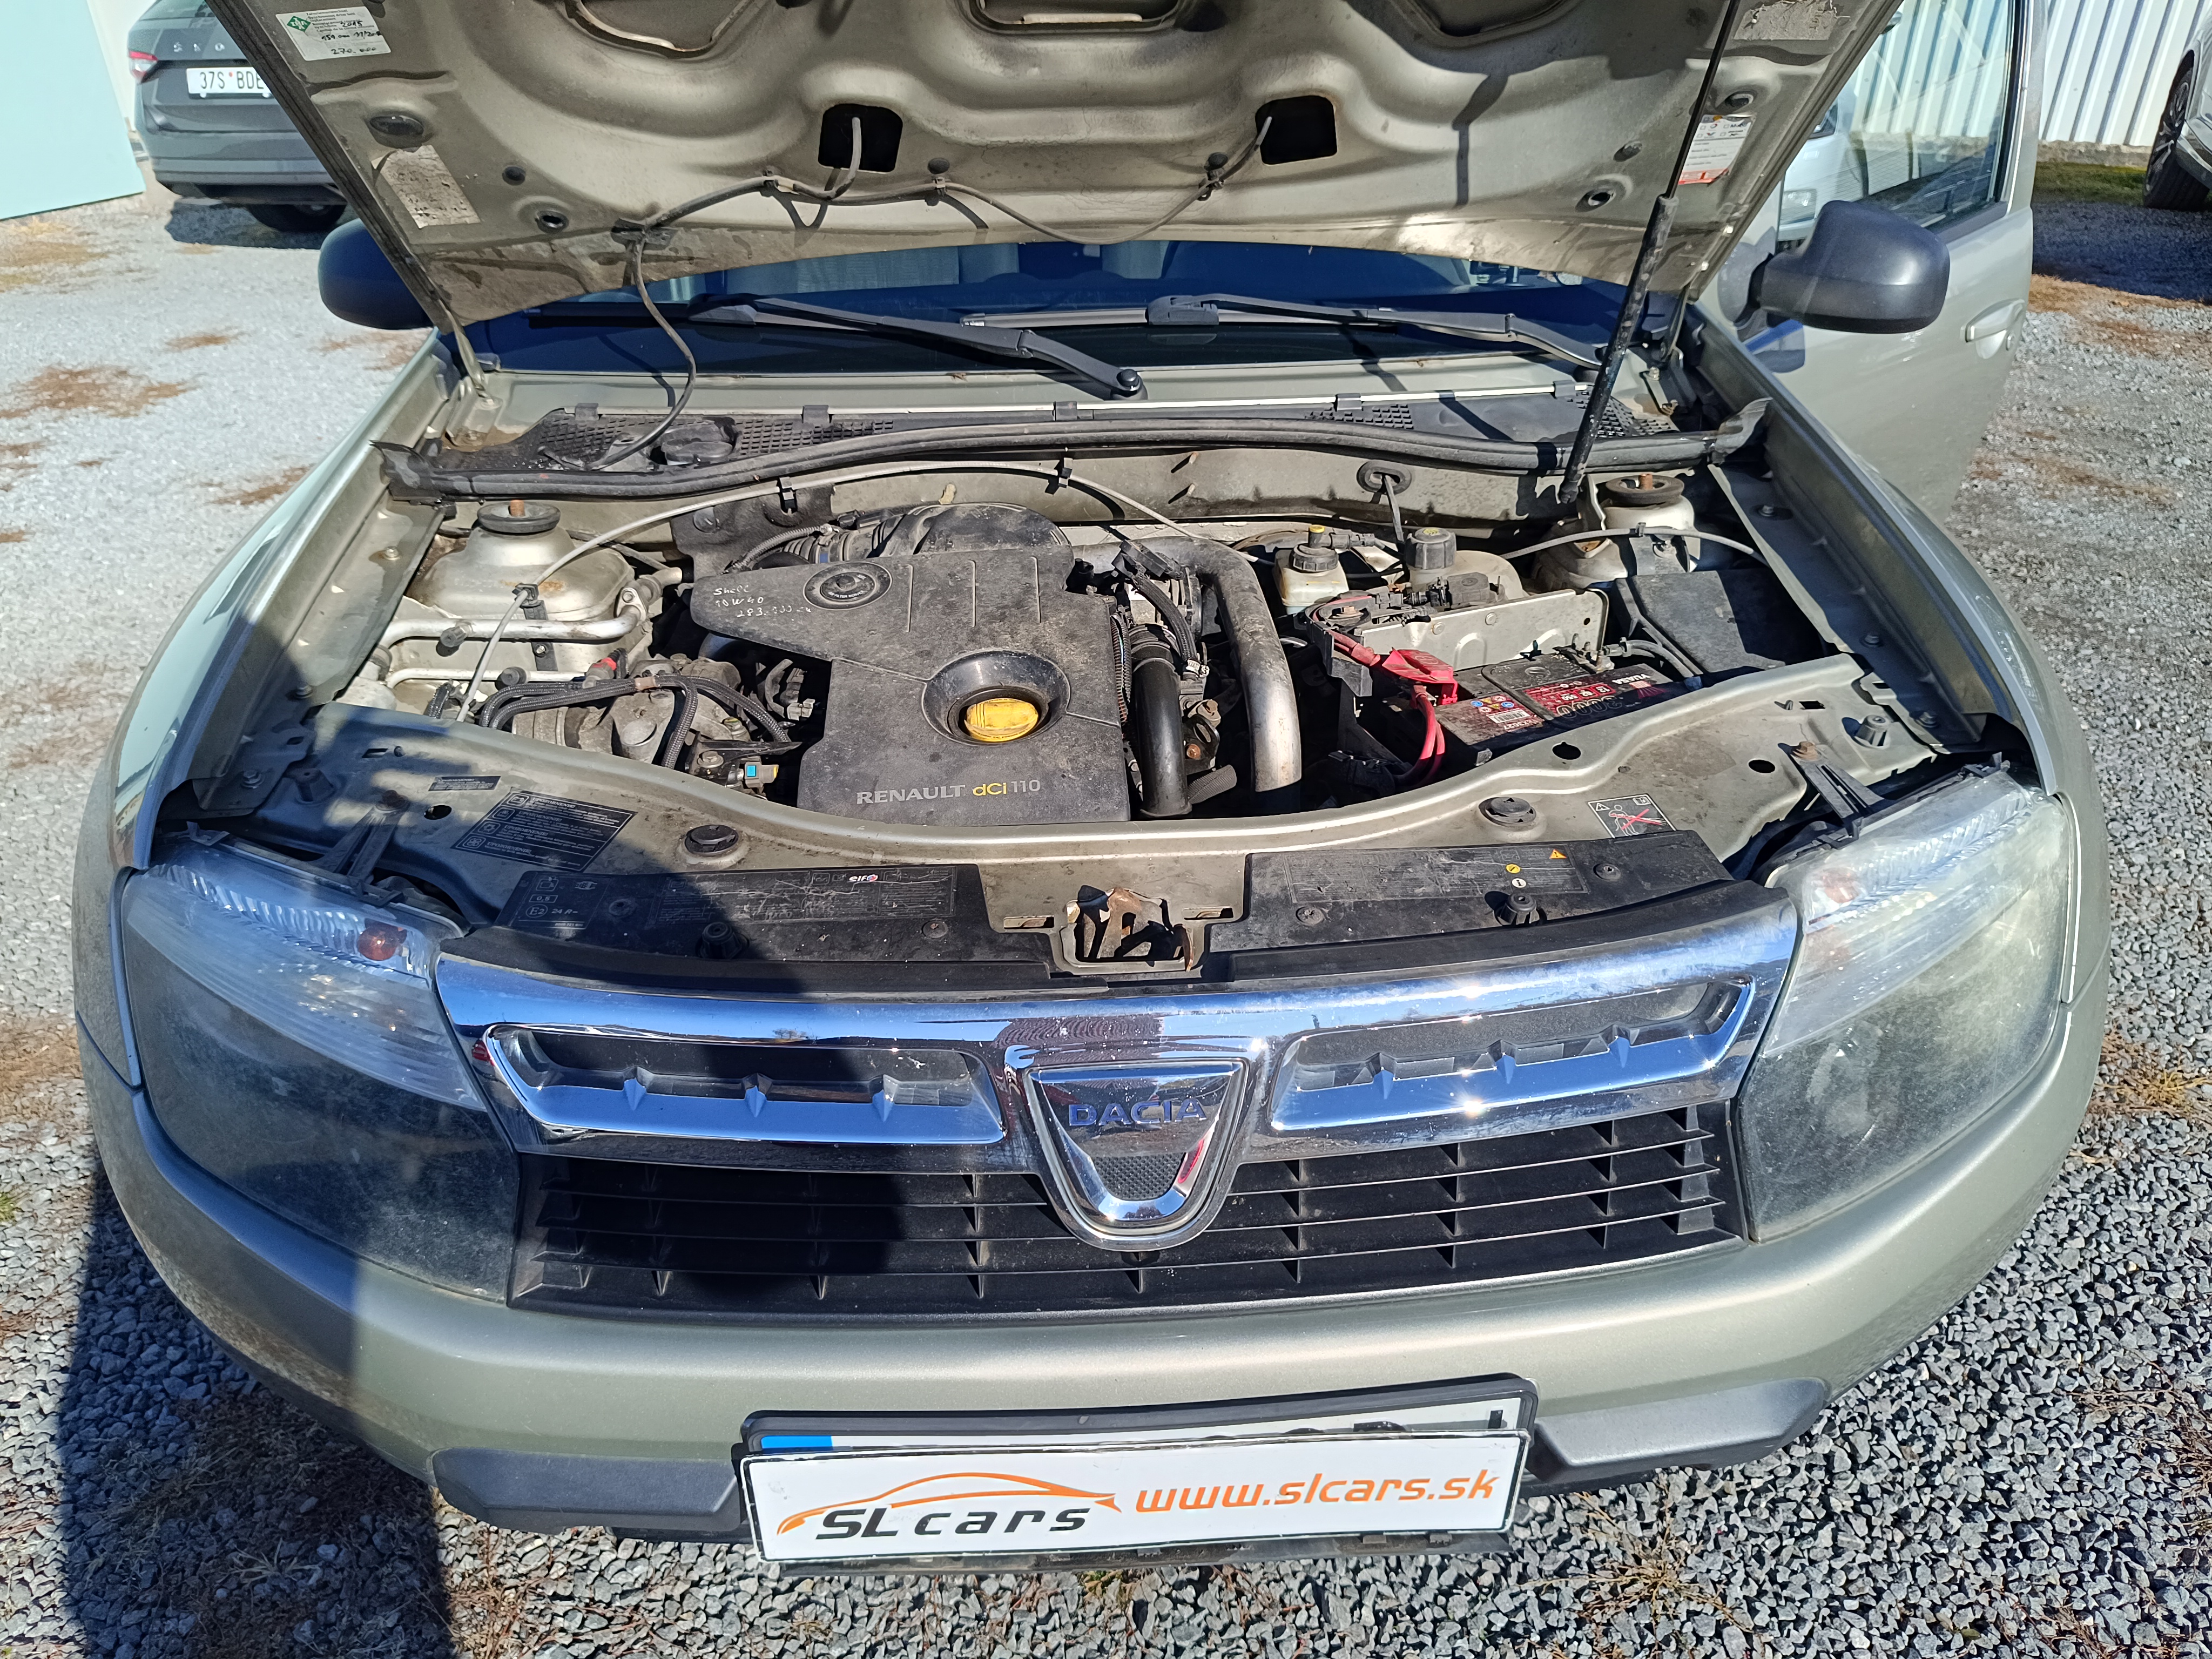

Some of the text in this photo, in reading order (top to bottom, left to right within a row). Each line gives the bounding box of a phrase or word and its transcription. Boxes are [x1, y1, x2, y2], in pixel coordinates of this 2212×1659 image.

[199, 71, 225, 89] 37S
[1611, 673, 1652, 684] YUASA
[1556, 695, 1622, 719] 3000
[857, 779, 1040, 804] RENAULT dCi 110
[529, 907, 545, 915] E2
[1068, 1097, 1207, 1127] DACIA
[1135, 1469, 1500, 1513] www.slcars.sk
